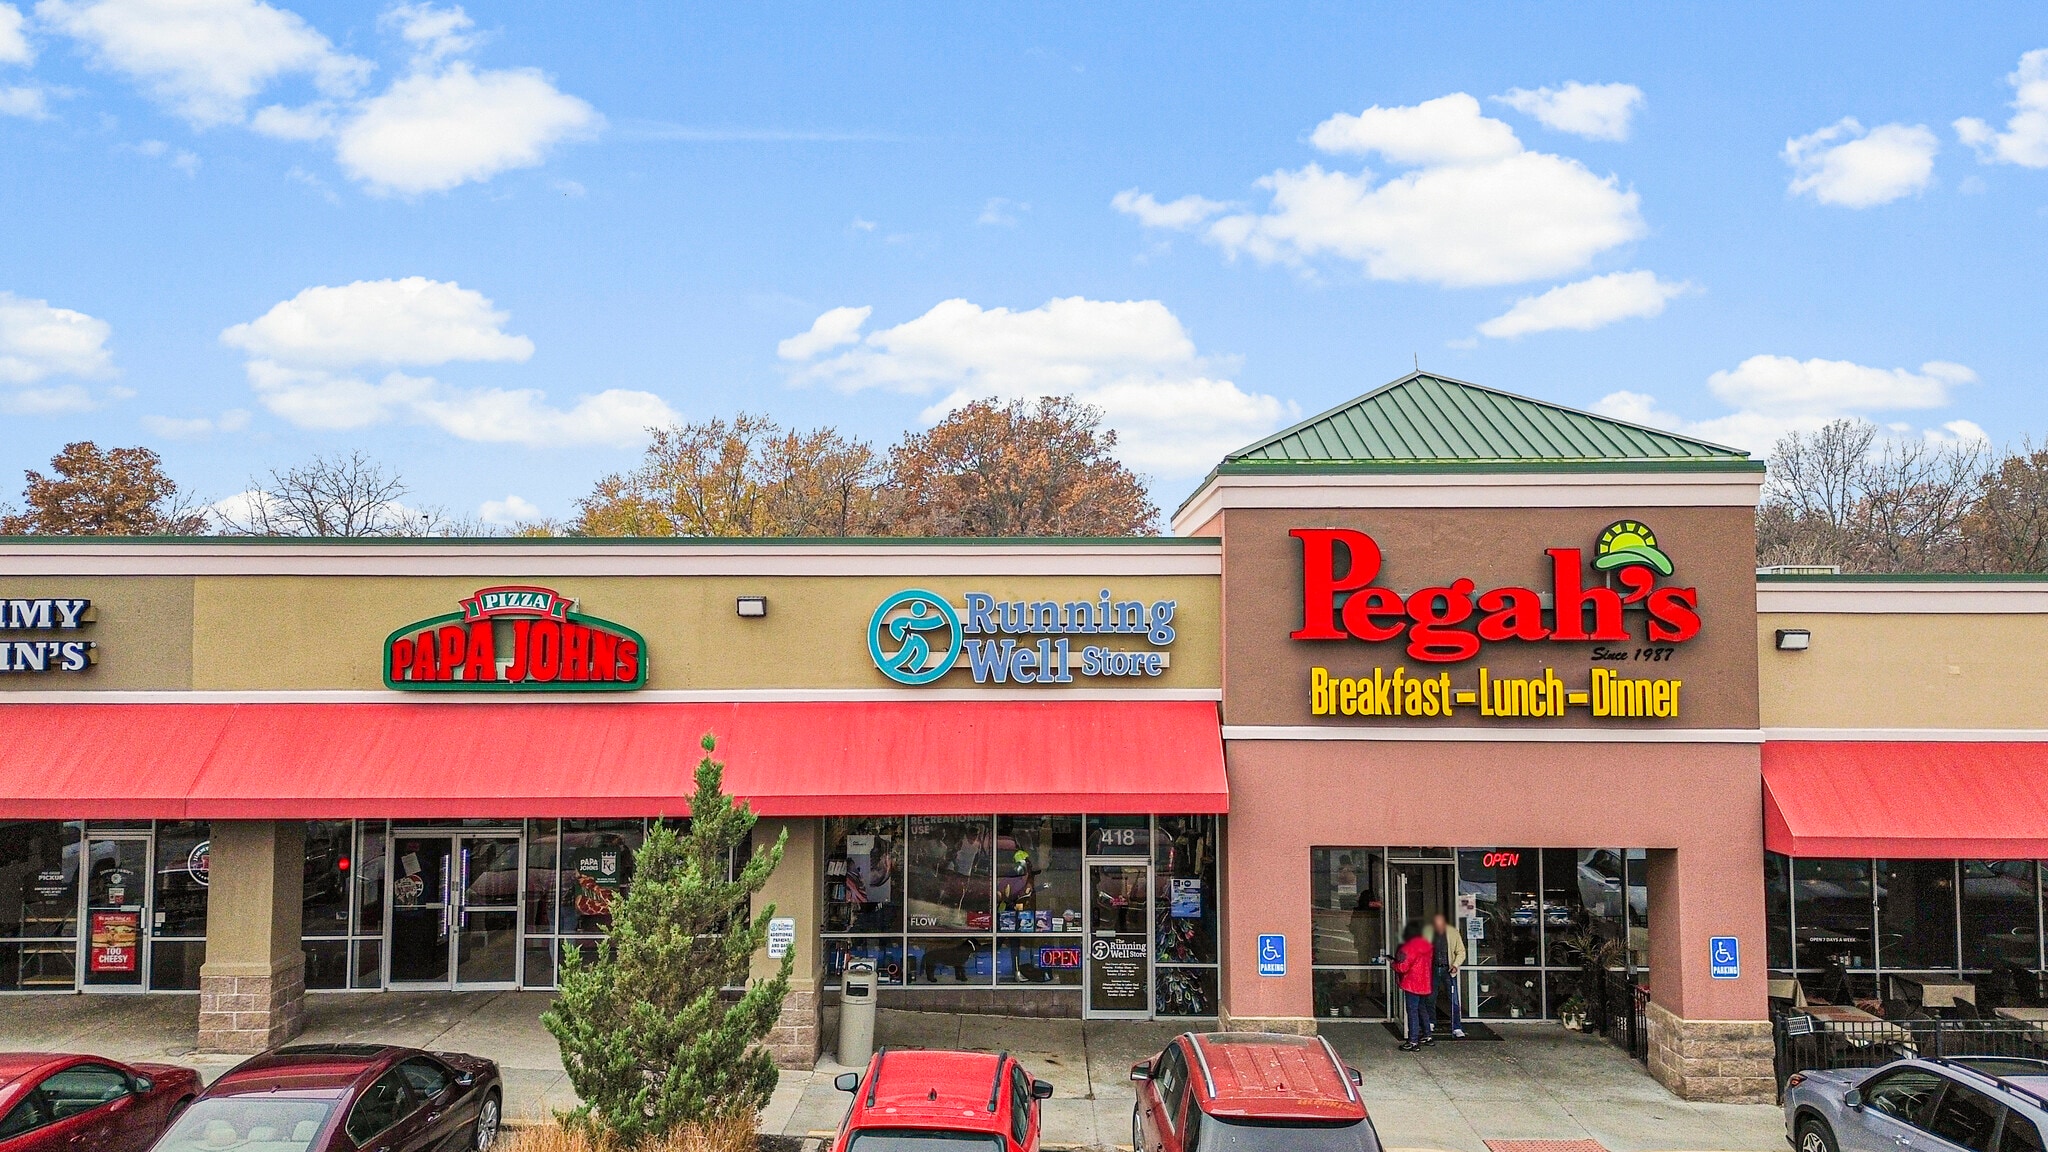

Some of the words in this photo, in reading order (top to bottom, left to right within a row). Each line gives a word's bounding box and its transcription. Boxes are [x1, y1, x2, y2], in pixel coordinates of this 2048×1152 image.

[484, 592, 548, 610] PIZZA
[1288, 527, 1702, 663] Pegah's
[964, 589, 1176, 646] Running
[391, 619, 498, 682] PAPA
[1591, 646, 1628, 661] Since
[1634, 648, 1675, 662] 1987
[964, 637, 1074, 684] Well
[1081, 645, 1163, 677] Store
[1310, 666, 1453, 718] Breakfast
[1479, 667, 1566, 718] Lunch
[1591, 667, 1683, 718] Dinner
[910, 814, 990, 825] RECREATIONAL
[911, 825, 930, 835] USE
[1102, 829, 1135, 846] 418
[580, 858, 598, 866] PAPA
[1482, 852, 1520, 868] OPEN
[910, 917, 937, 926] FLOW
[106, 947, 122, 955] TOO
[1110, 941, 1147, 952] Running
[98, 955, 128, 963] CHEESY
[1042, 950, 1079, 966] OPEN
[1110, 949, 1130, 958] Well
[1260, 963, 1284, 972] PARKING
[1713, 966, 1737, 975] PARKING
